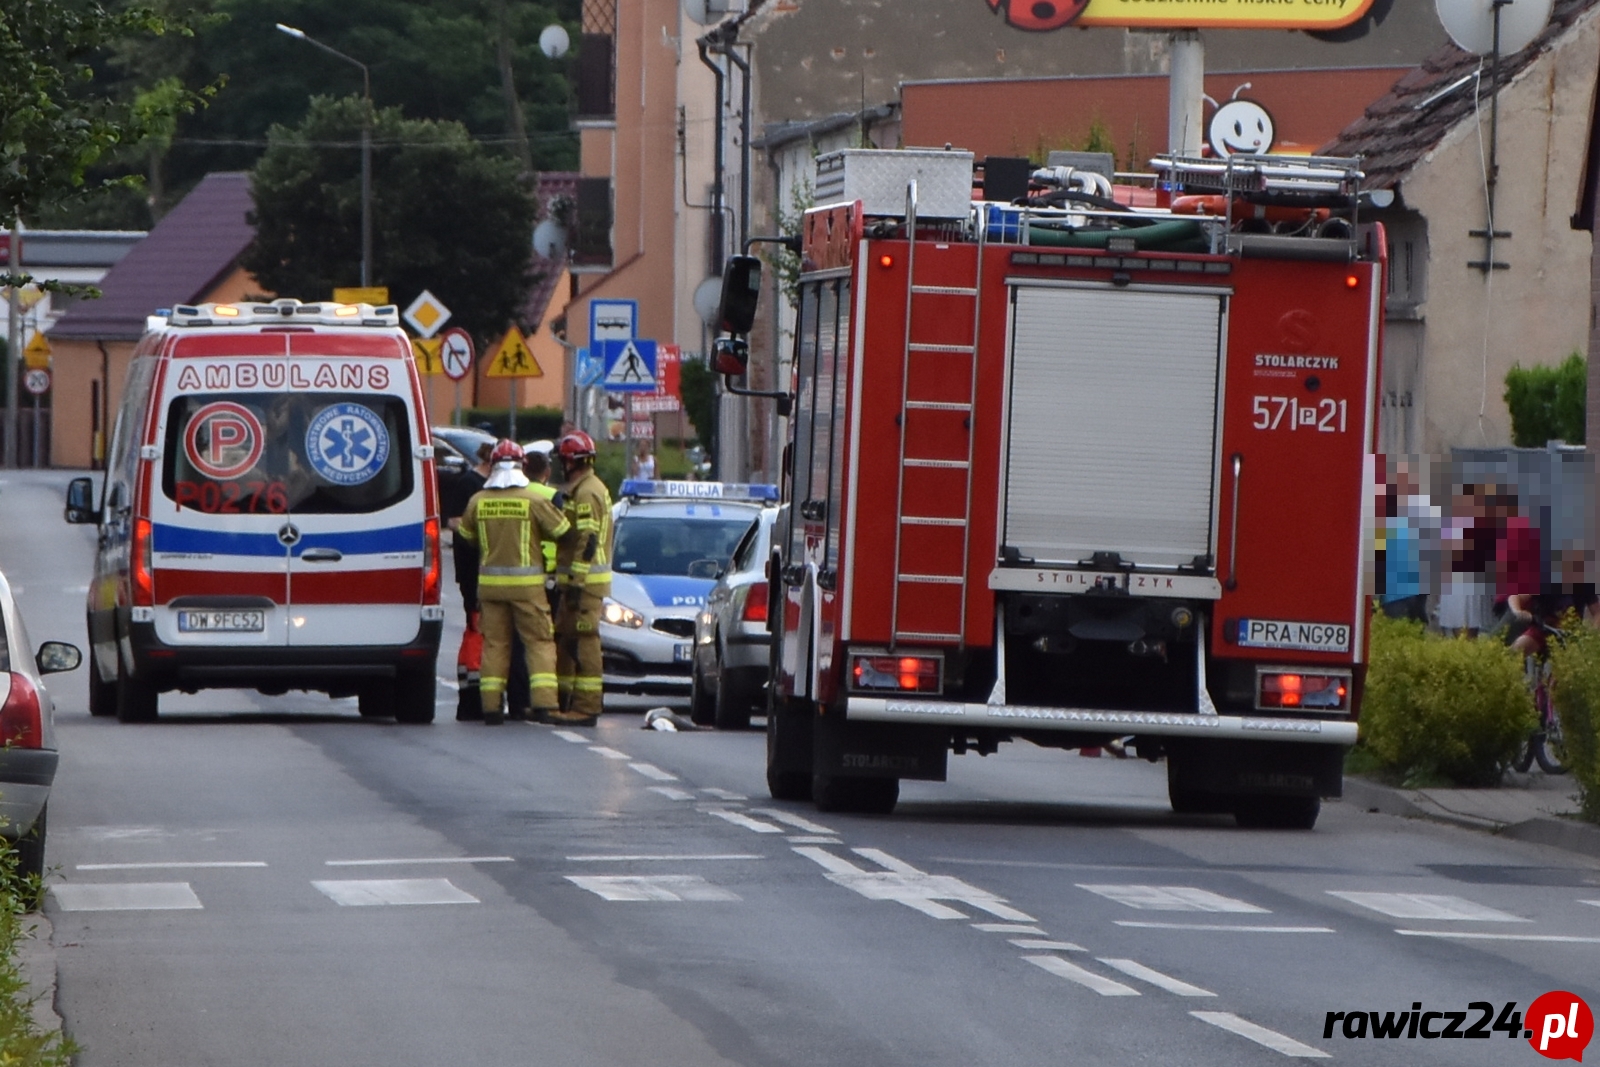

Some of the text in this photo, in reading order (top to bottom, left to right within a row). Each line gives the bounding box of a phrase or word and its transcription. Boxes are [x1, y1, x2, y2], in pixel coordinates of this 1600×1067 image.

[1255, 354, 1338, 369] STOLARCZYK
[178, 363, 389, 390] AMBULANS
[209, 419, 248, 464] P
[175, 481, 288, 513] P0276
[670, 483, 720, 496] POLICJA
[189, 612, 208, 627] DW
[1251, 622, 1346, 645] PRA NG98
